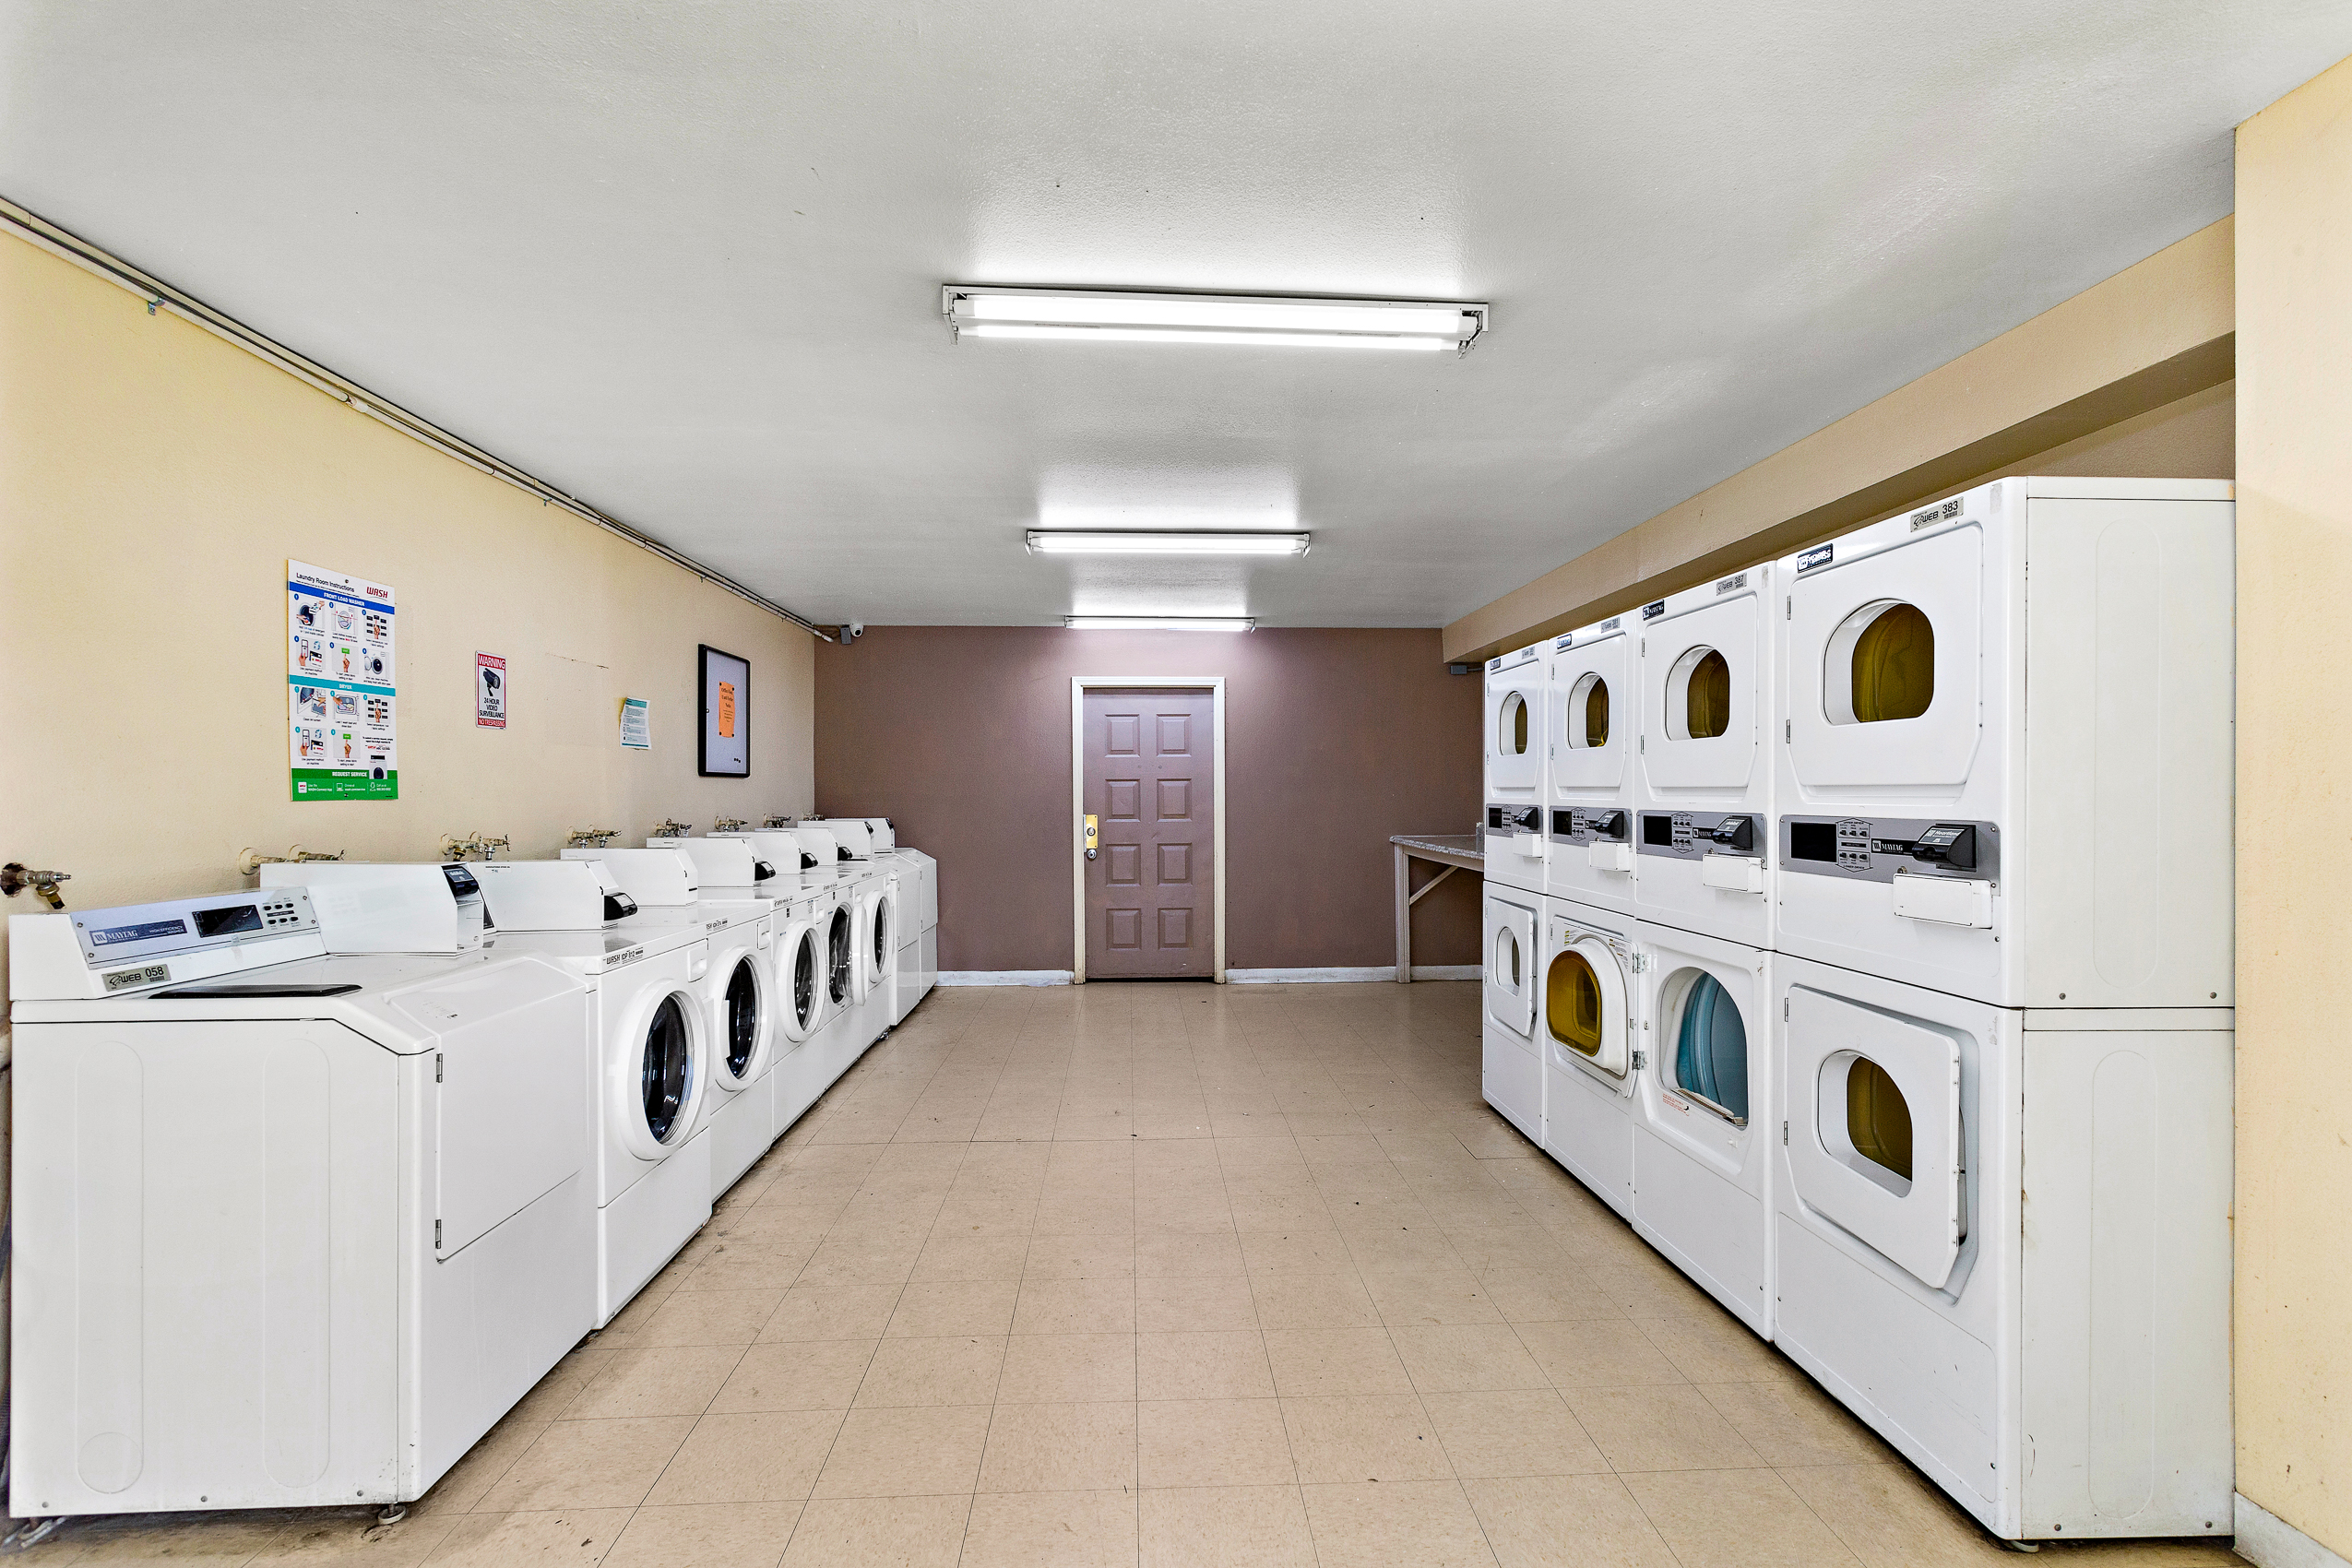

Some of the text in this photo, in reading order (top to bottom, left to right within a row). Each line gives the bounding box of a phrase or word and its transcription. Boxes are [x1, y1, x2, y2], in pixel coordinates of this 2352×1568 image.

[1922, 511, 1939, 523] WEB
[1942, 500, 1958, 515] 383
[296, 572, 315, 583] Laundry
[315, 577, 329, 586] Room
[329, 581, 355, 592] Instructions
[1734, 575, 1744, 585] 387
[366, 586, 388, 599] WASH
[324, 592, 337, 600] FRONT
[349, 598, 365, 606] WASHER
[478, 654, 505, 670] WARNING
[479, 710, 505, 719] SURVEILLANCE
[485, 719, 505, 728] TRESPASSING
[1881, 843, 1904, 851] MAYTAG
[106, 930, 138, 940] MAYTAG
[606, 954, 621, 965] WASH
[121, 966, 164, 983] WEB 058
